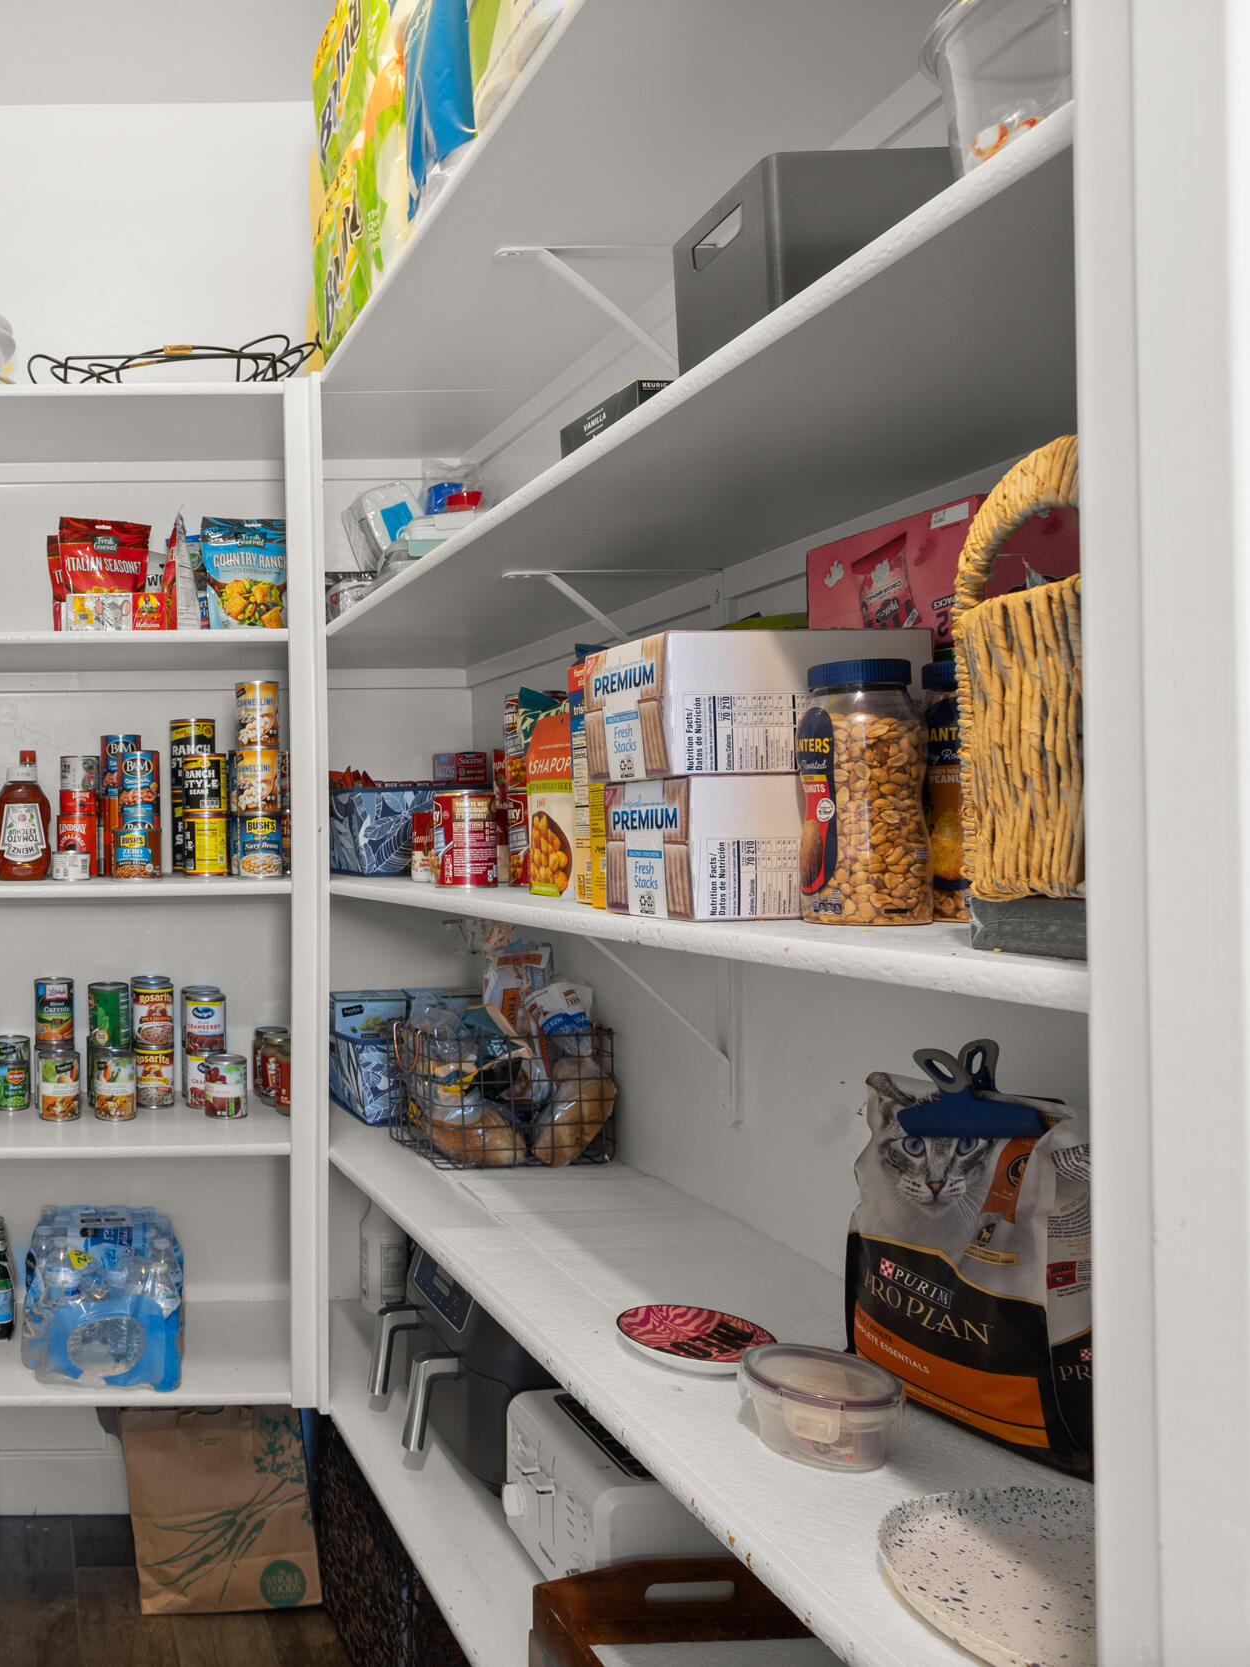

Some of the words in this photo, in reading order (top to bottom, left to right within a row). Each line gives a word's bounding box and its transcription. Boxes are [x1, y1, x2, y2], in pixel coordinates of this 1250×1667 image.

[583, 412, 607, 432] VANILLA
[66, 556, 103, 572] ITALIAN
[212, 551, 257, 568] COUNTRY
[933, 595, 957, 609] PACKS
[594, 663, 655, 697] PREMIUM
[722, 696, 731, 710] 210
[693, 697, 702, 734] Nutrición
[722, 712, 731, 722] 70
[614, 724, 633, 739] Fresh
[614, 738, 637, 753] Stacks
[694, 736, 702, 746] de
[172, 744, 211, 756] RANCH
[685, 736, 694, 771] Nutrition
[125, 760, 150, 771] B&M
[694, 748, 703, 771] Datos
[185, 769, 216, 779] RANCH
[184, 779, 219, 789] STYLE
[247, 821, 276, 831] BUSH'S
[612, 807, 678, 831] PREMIUM
[59, 823, 87, 834] LINDSAY
[7, 834, 38, 843] TOMATO
[11, 846, 35, 855] HEINZ
[746, 840, 755, 855] 210
[717, 842, 726, 879] Nutrición
[746, 856, 755, 866] 70
[634, 861, 654, 875] Fresh
[634, 874, 659, 890] Stacks
[718, 881, 726, 891] de
[709, 881, 718, 916] Nutrition
[718, 893, 726, 916] Datos
[139, 993, 172, 1004] Rosarita
[905, 1296, 989, 1345] PLAN
[880, 1341, 930, 1374] ESSENTIALS
[264, 1573, 300, 1586] WHOLE
[266, 1582, 301, 1594] FOODS
